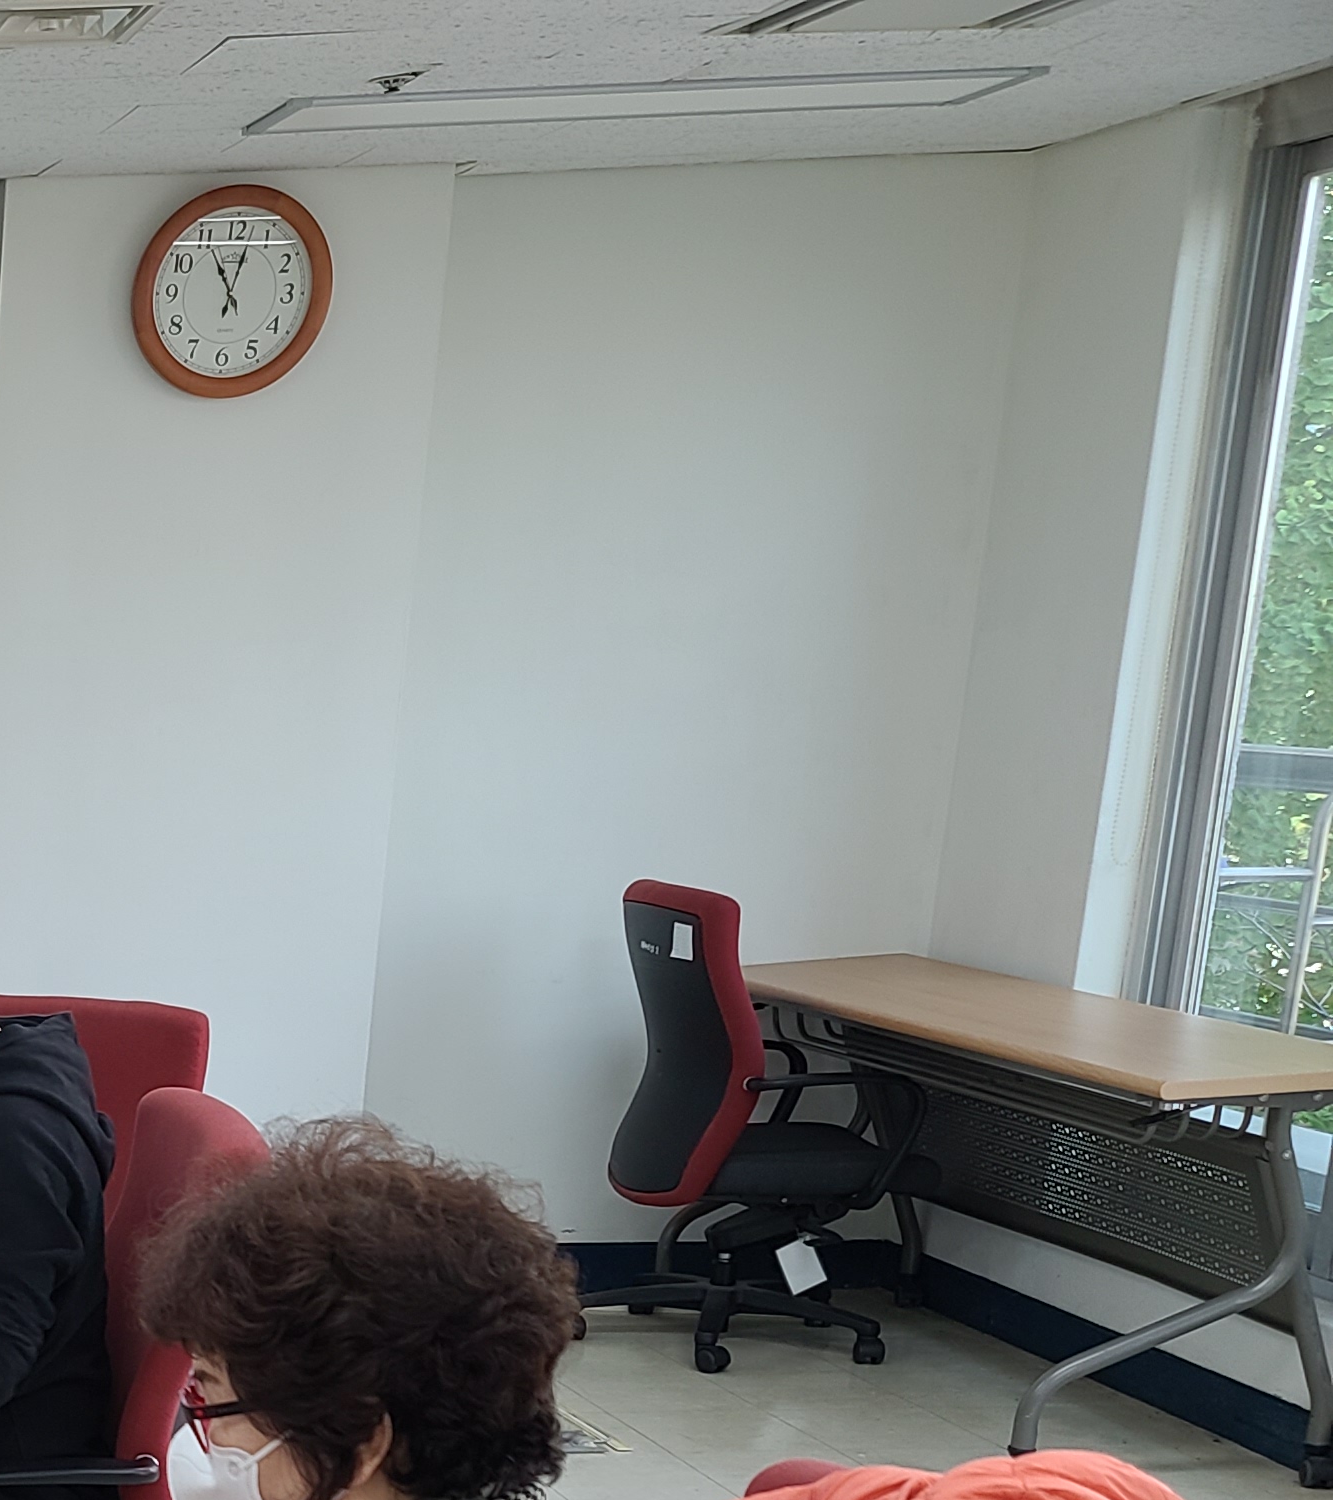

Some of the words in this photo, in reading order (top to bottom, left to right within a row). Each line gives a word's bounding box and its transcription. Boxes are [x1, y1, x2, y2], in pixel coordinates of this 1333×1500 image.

[196, 228, 214, 250] 11
[227, 219, 248, 241] 12
[263, 229, 271, 250] 1
[173, 252, 194, 274] 10
[278, 252, 292, 274] 2
[165, 283, 179, 304] 9
[279, 283, 295, 305] 3
[168, 314, 184, 336] 8
[265, 314, 281, 335] 4
[187, 338, 200, 360] 7
[214, 346, 229, 367] 6
[243, 338, 259, 360] 5
